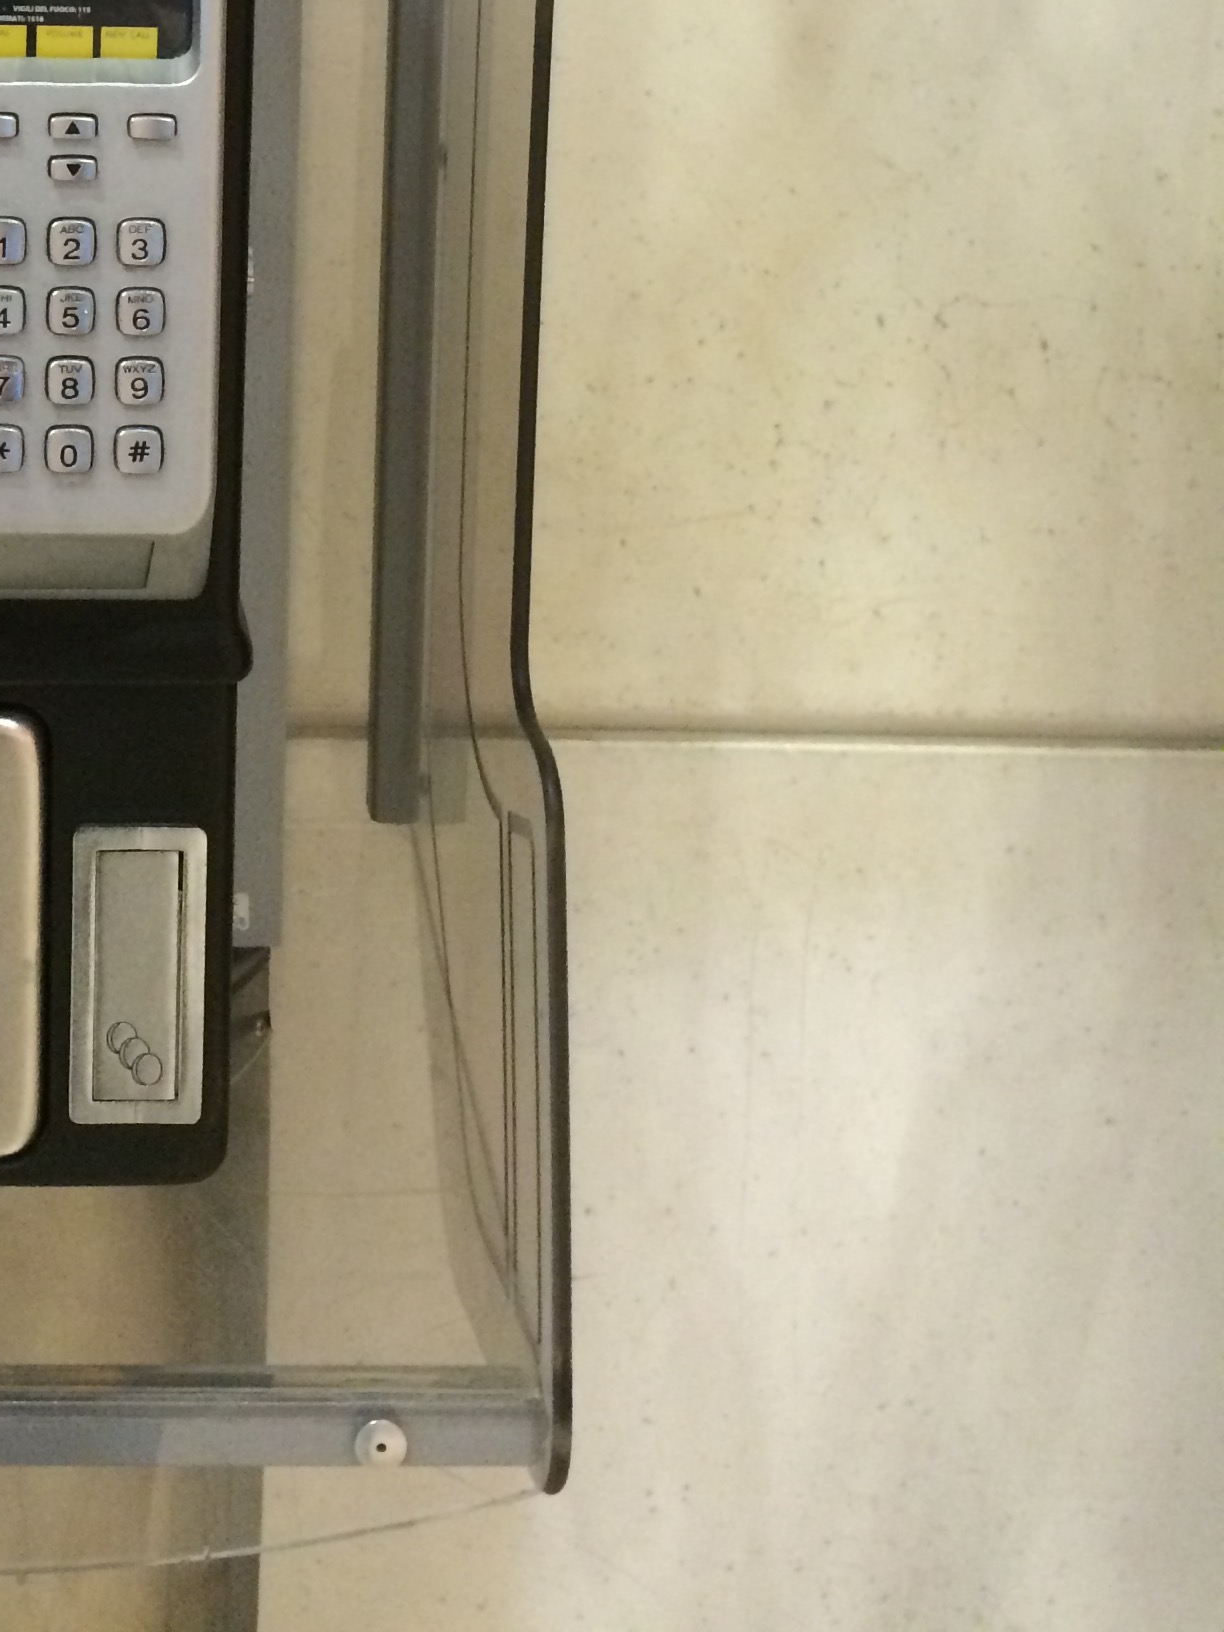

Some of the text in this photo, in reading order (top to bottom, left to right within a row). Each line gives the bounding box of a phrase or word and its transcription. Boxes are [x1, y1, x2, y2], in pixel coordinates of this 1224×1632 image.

[60, 224, 85, 233] ABC
[129, 225, 153, 234] DEF
[63, 238, 81, 260] 2
[131, 239, 149, 260] 3
[62, 307, 80, 328] 5
[132, 309, 150, 330] 6
[59, 365, 82, 374] TUV
[61, 377, 79, 399] 8
[130, 378, 148, 399] 9
